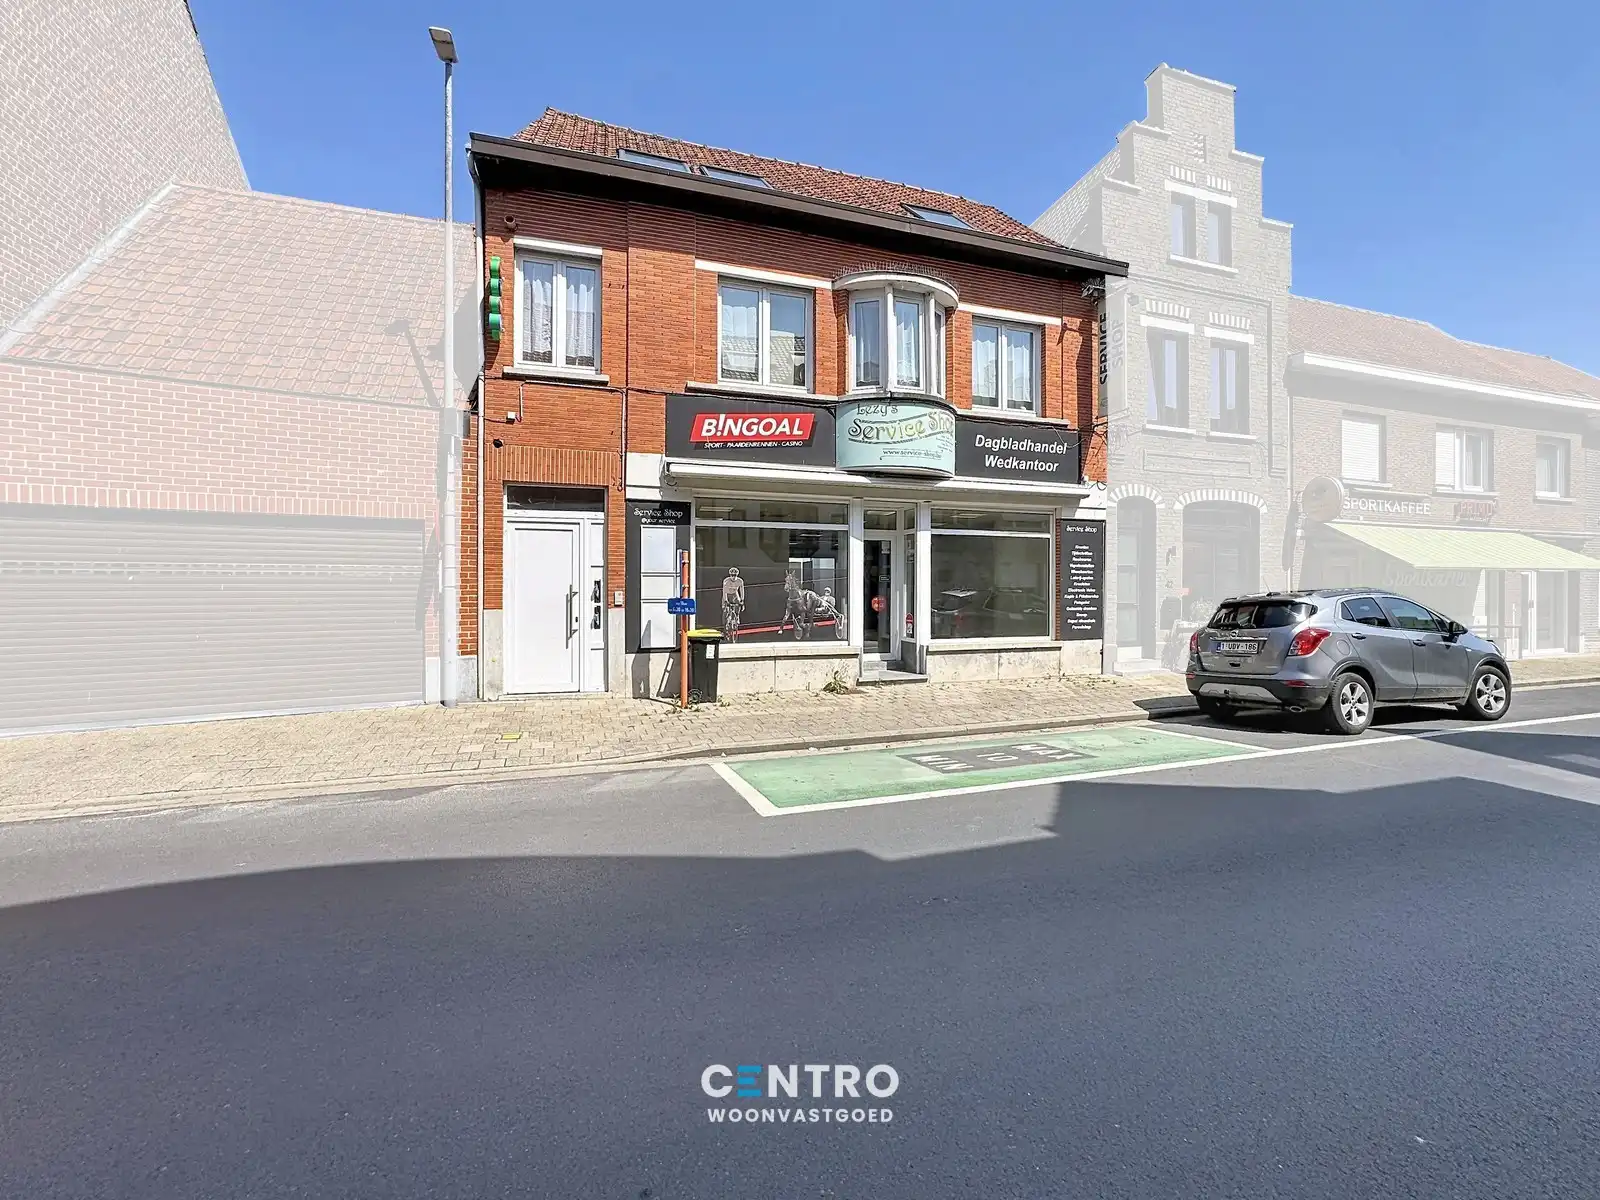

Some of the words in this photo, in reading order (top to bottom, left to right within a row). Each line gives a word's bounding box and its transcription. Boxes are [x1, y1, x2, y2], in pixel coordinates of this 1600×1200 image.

[848, 417, 926, 441] Service
[703, 441, 724, 449] SPORT
[726, 440, 778, 449] PAARDENRENNEN
[975, 434, 1067, 455] Dagbladhandel
[985, 454, 1059, 472] Wedkantoor
[633, 507, 662, 517] Service
[664, 508, 684, 518] Shop
[1342, 496, 1432, 515] SPORTKAFFEE
[1011, 743, 1083, 760] MAX
[911, 754, 975, 771] MIN
